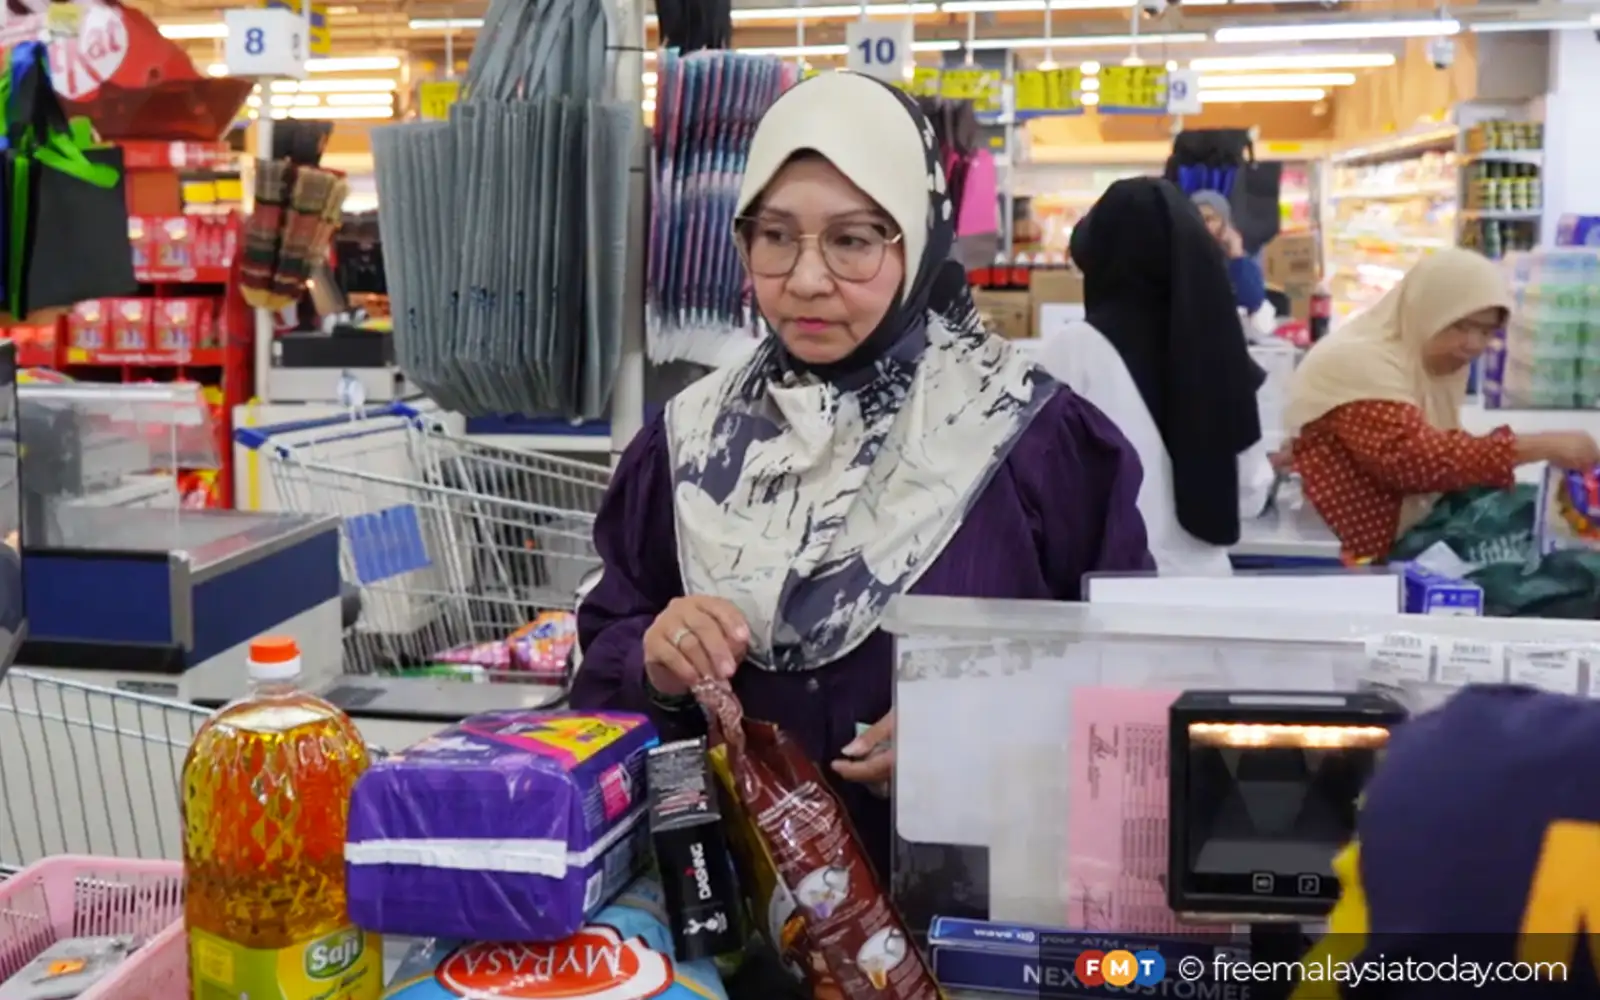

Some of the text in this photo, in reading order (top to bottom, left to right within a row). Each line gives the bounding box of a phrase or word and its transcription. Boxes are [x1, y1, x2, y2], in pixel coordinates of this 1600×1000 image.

[245, 28, 264, 55] 8
[857, 37, 895, 65] 10
[1172, 80, 1187, 100] 9
[309, 935, 359, 971] Saji
[1023, 964, 1088, 989] NEX
